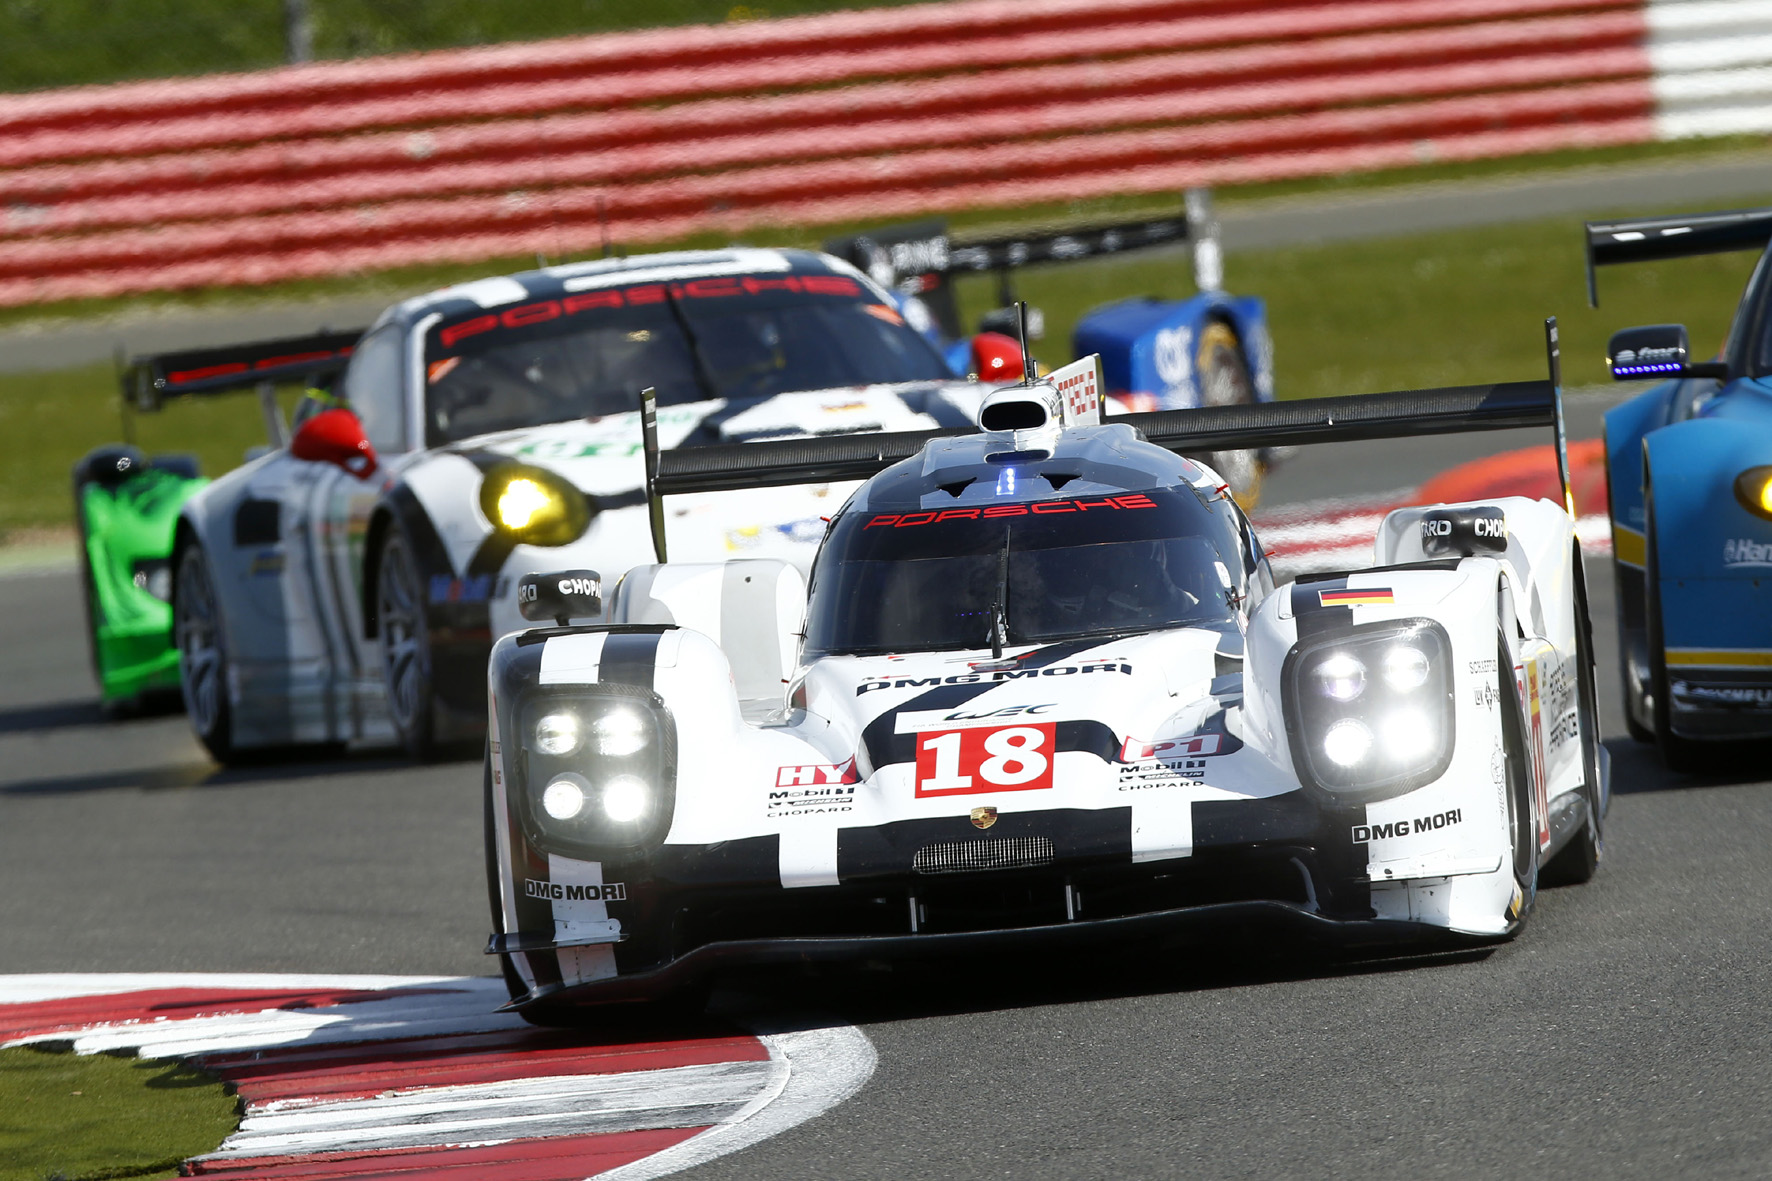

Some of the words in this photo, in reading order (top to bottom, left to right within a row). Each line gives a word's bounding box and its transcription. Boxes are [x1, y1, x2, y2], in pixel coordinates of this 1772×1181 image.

[440, 275, 862, 348] PORSCHE
[862, 494, 1158, 530] PORSCHE
[856, 673, 981, 697] DMG
[992, 663, 1132, 681] MORI
[943, 703, 1058, 721] WEC
[1141, 738, 1203, 757] P1
[921, 727, 1047, 791] 18
[1120, 762, 1182, 773] Mobil
[778, 757, 854, 786] HY
[769, 788, 831, 799] Mobil
[1118, 781, 1204, 791] CHOPARD
[767, 806, 852, 818] CHOPARD
[1353, 821, 1410, 842] DMG
[1414, 808, 1462, 834] MORI
[526, 880, 563, 899] DMG
[566, 884, 625, 901] MORI
